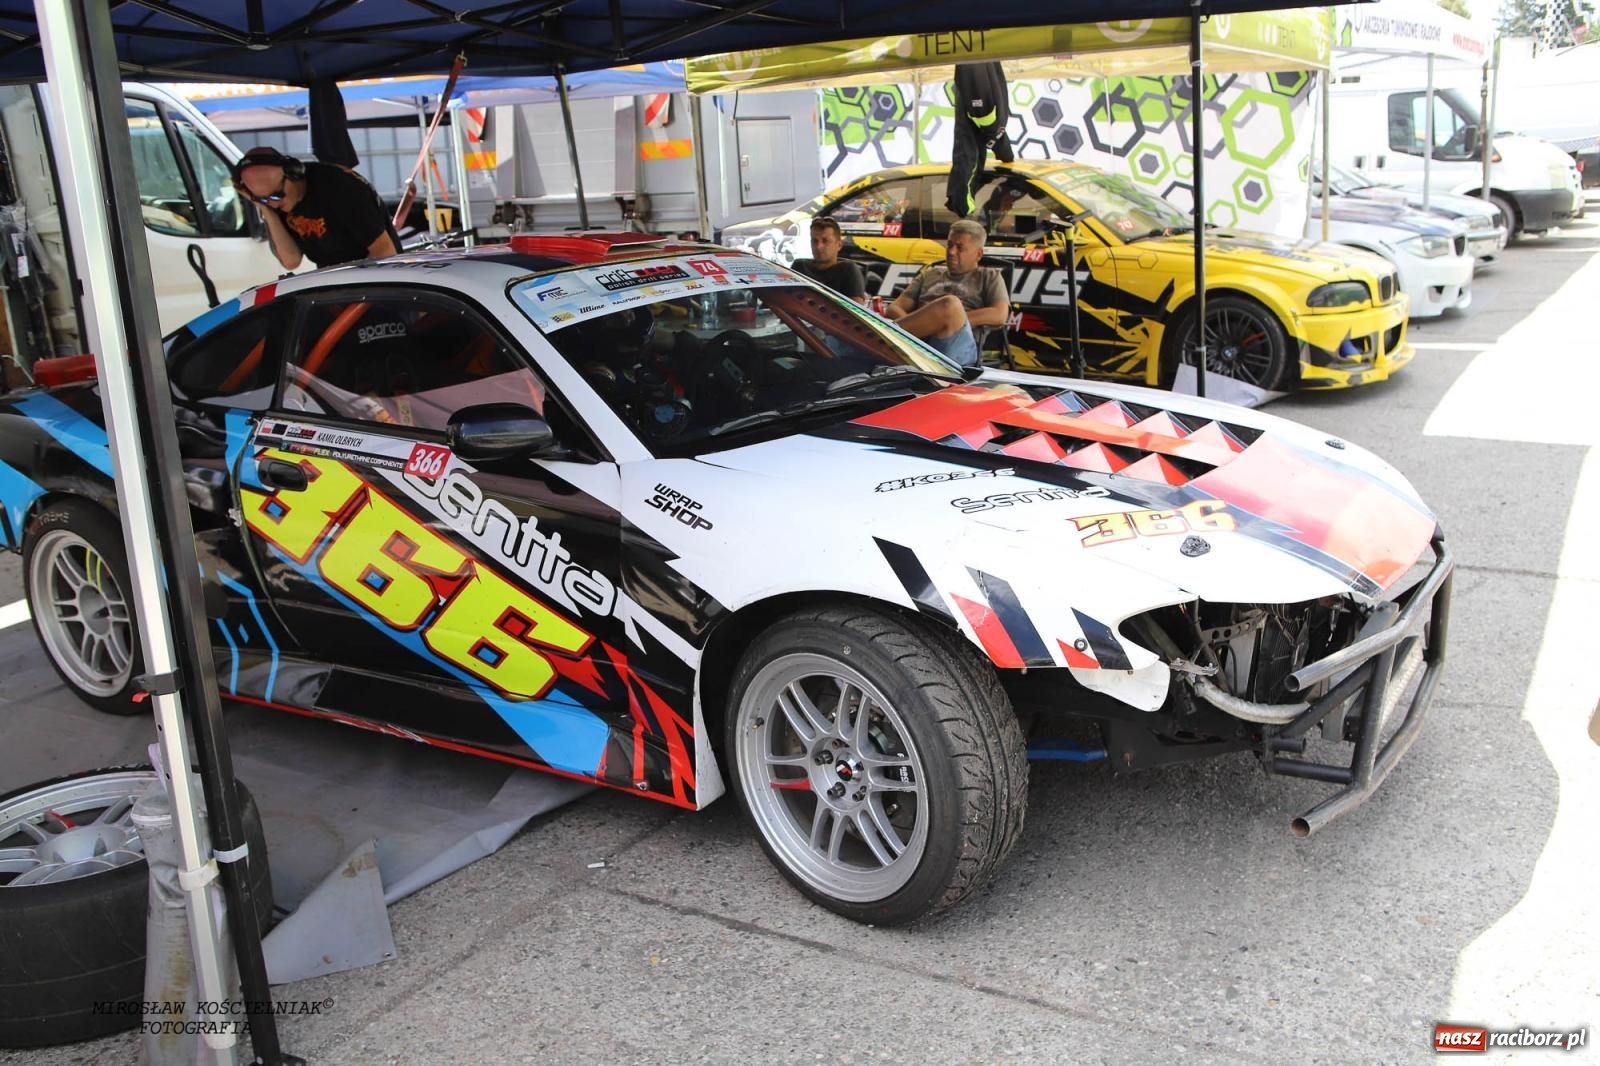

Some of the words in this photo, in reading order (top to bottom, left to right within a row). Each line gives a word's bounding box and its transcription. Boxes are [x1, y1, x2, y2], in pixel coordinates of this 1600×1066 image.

[917, 29, 991, 56] TENT
[883, 224, 900, 235] 747
[694, 262, 719, 273] 74
[1024, 250, 1044, 262] 747
[357, 322, 407, 343] sparco
[316, 432, 335, 444] KAMIL
[334, 435, 364, 447] OLBRYCH
[408, 448, 445, 476] 366
[654, 483, 703, 510] WRAP
[644, 494, 713, 530] SHOP
[1066, 499, 1239, 549] 366
